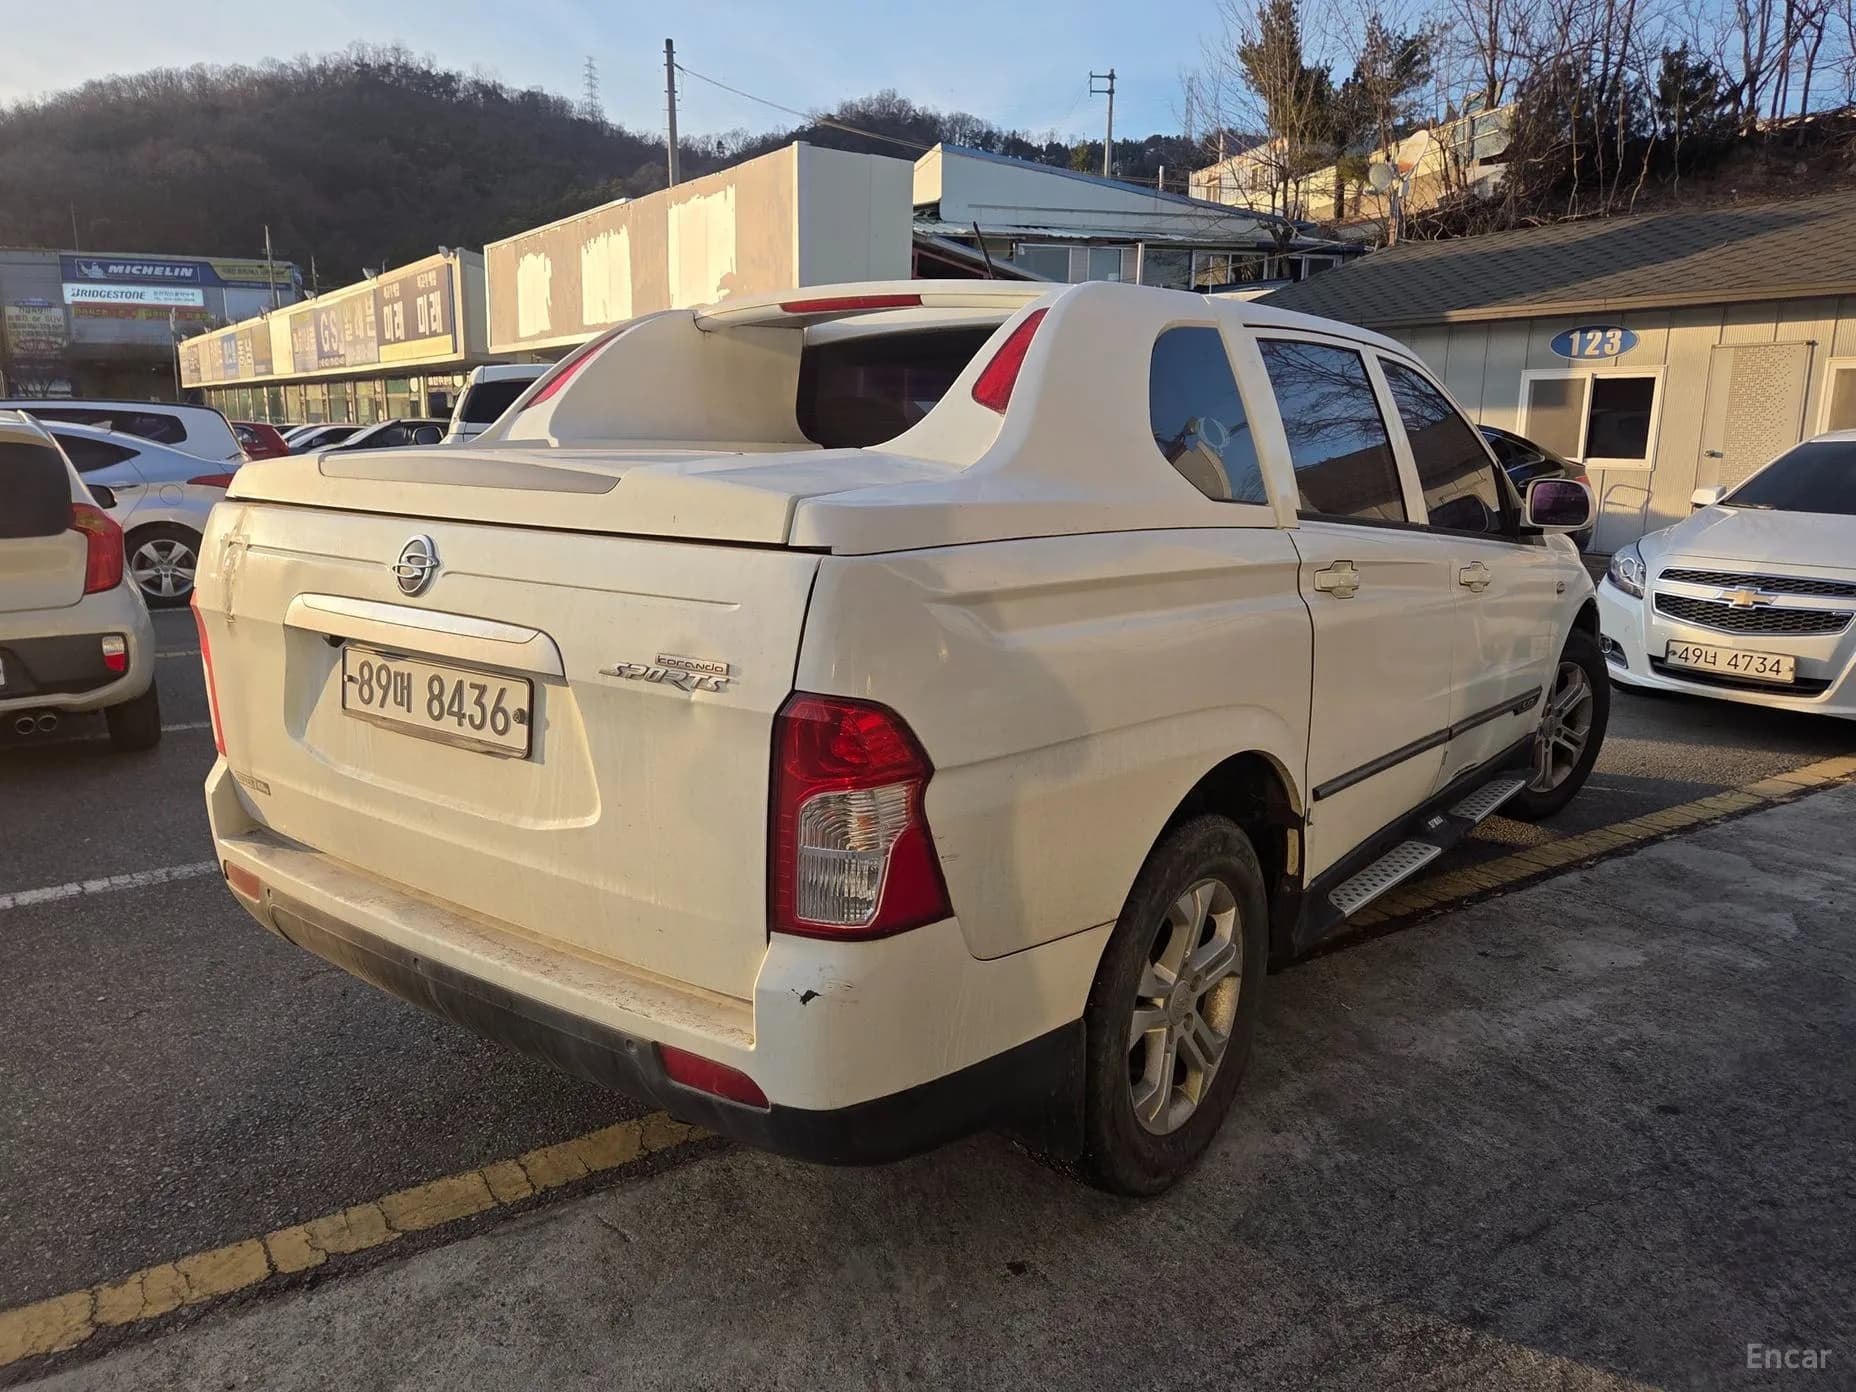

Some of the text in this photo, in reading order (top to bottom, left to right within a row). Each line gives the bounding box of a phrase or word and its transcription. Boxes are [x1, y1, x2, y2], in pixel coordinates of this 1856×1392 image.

[108, 264, 193, 277] MICHELIN
[71, 288, 146, 300] BRIDGESTONE
[1569, 328, 1622, 356] 123
[1678, 646, 1782, 676] 49너 4734
[599, 662, 731, 692] SPORTS
[358, 659, 512, 736] 89머 8436
